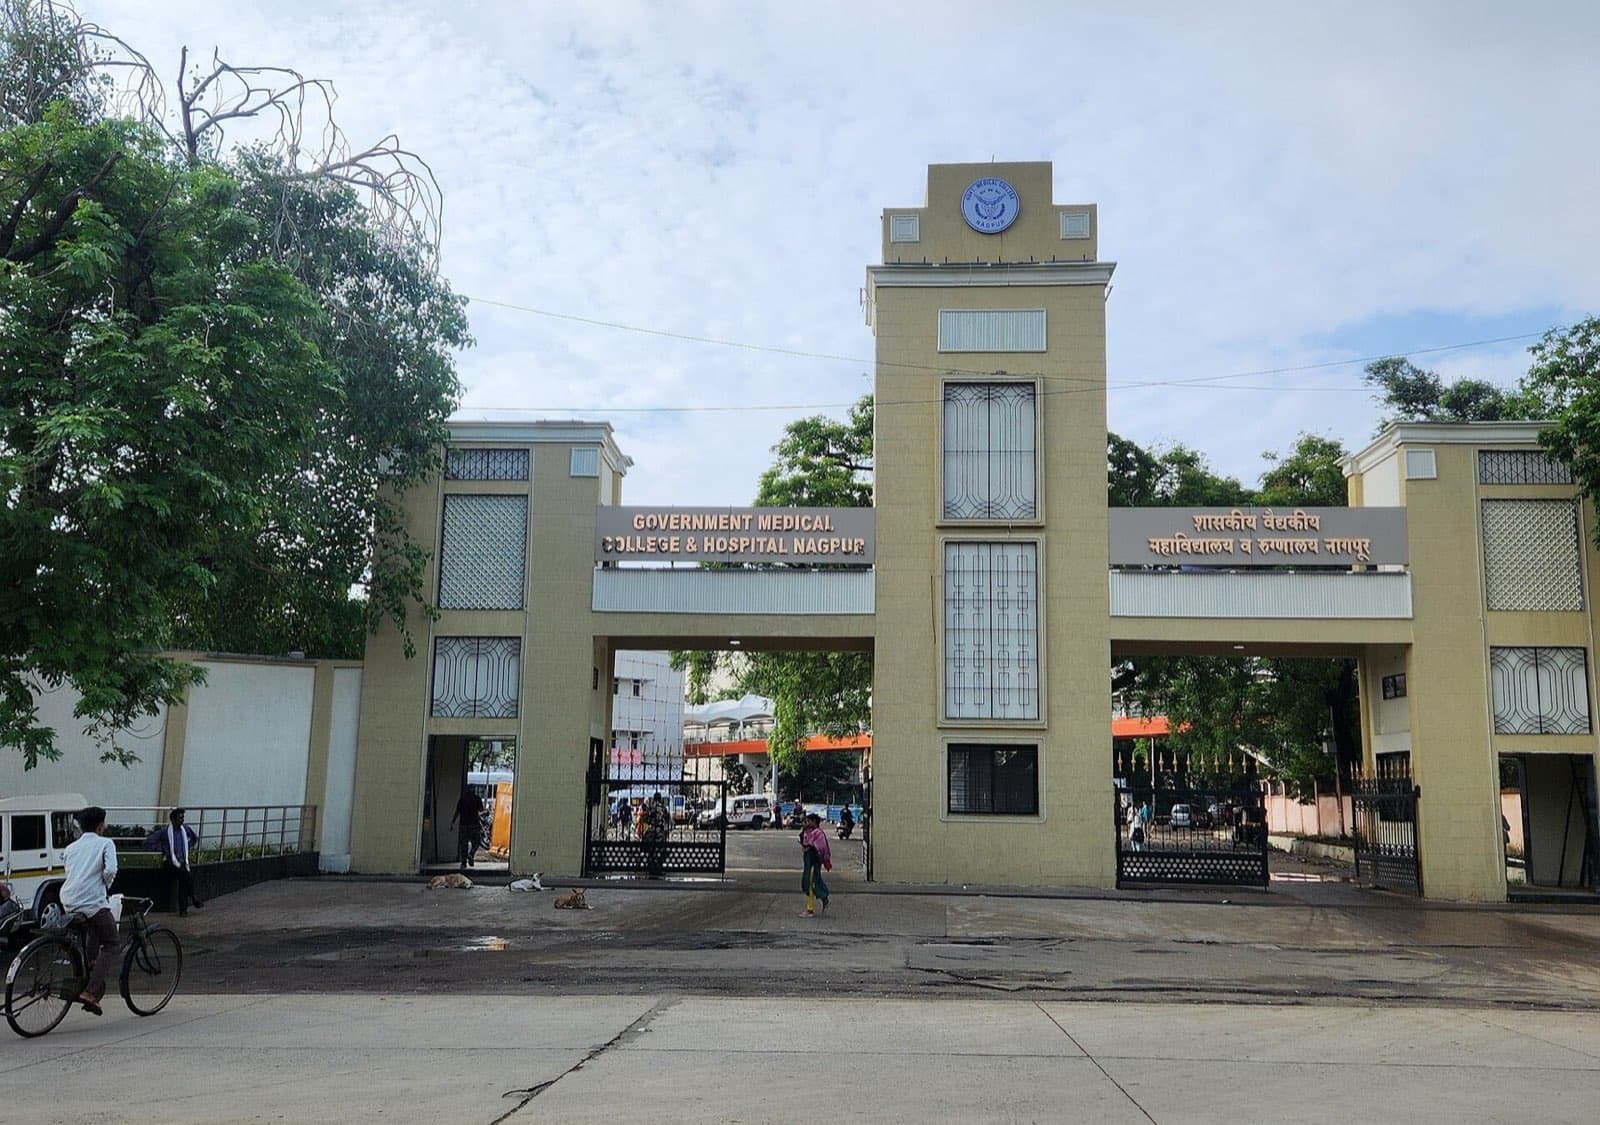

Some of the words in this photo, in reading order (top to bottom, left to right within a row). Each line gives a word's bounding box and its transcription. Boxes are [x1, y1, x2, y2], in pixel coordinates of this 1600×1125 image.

[976, 219, 1005, 228] NAGPUR
[632, 514, 752, 531] GOVERNMENT
[758, 514, 834, 531] MEDICAL
[1192, 509, 1258, 532] शासकीय
[602, 536, 680, 553] COLLEGE
[686, 536, 698, 553] &
[703, 536, 788, 553] HOSPITAL
[793, 537, 865, 555] NAGPUR
[1148, 532, 1234, 557] महाविद्यालय
[1239, 538, 1252, 554] व
[1257, 538, 1319, 554] रुग्णालय
[1324, 538, 1371, 561] नागपूर
